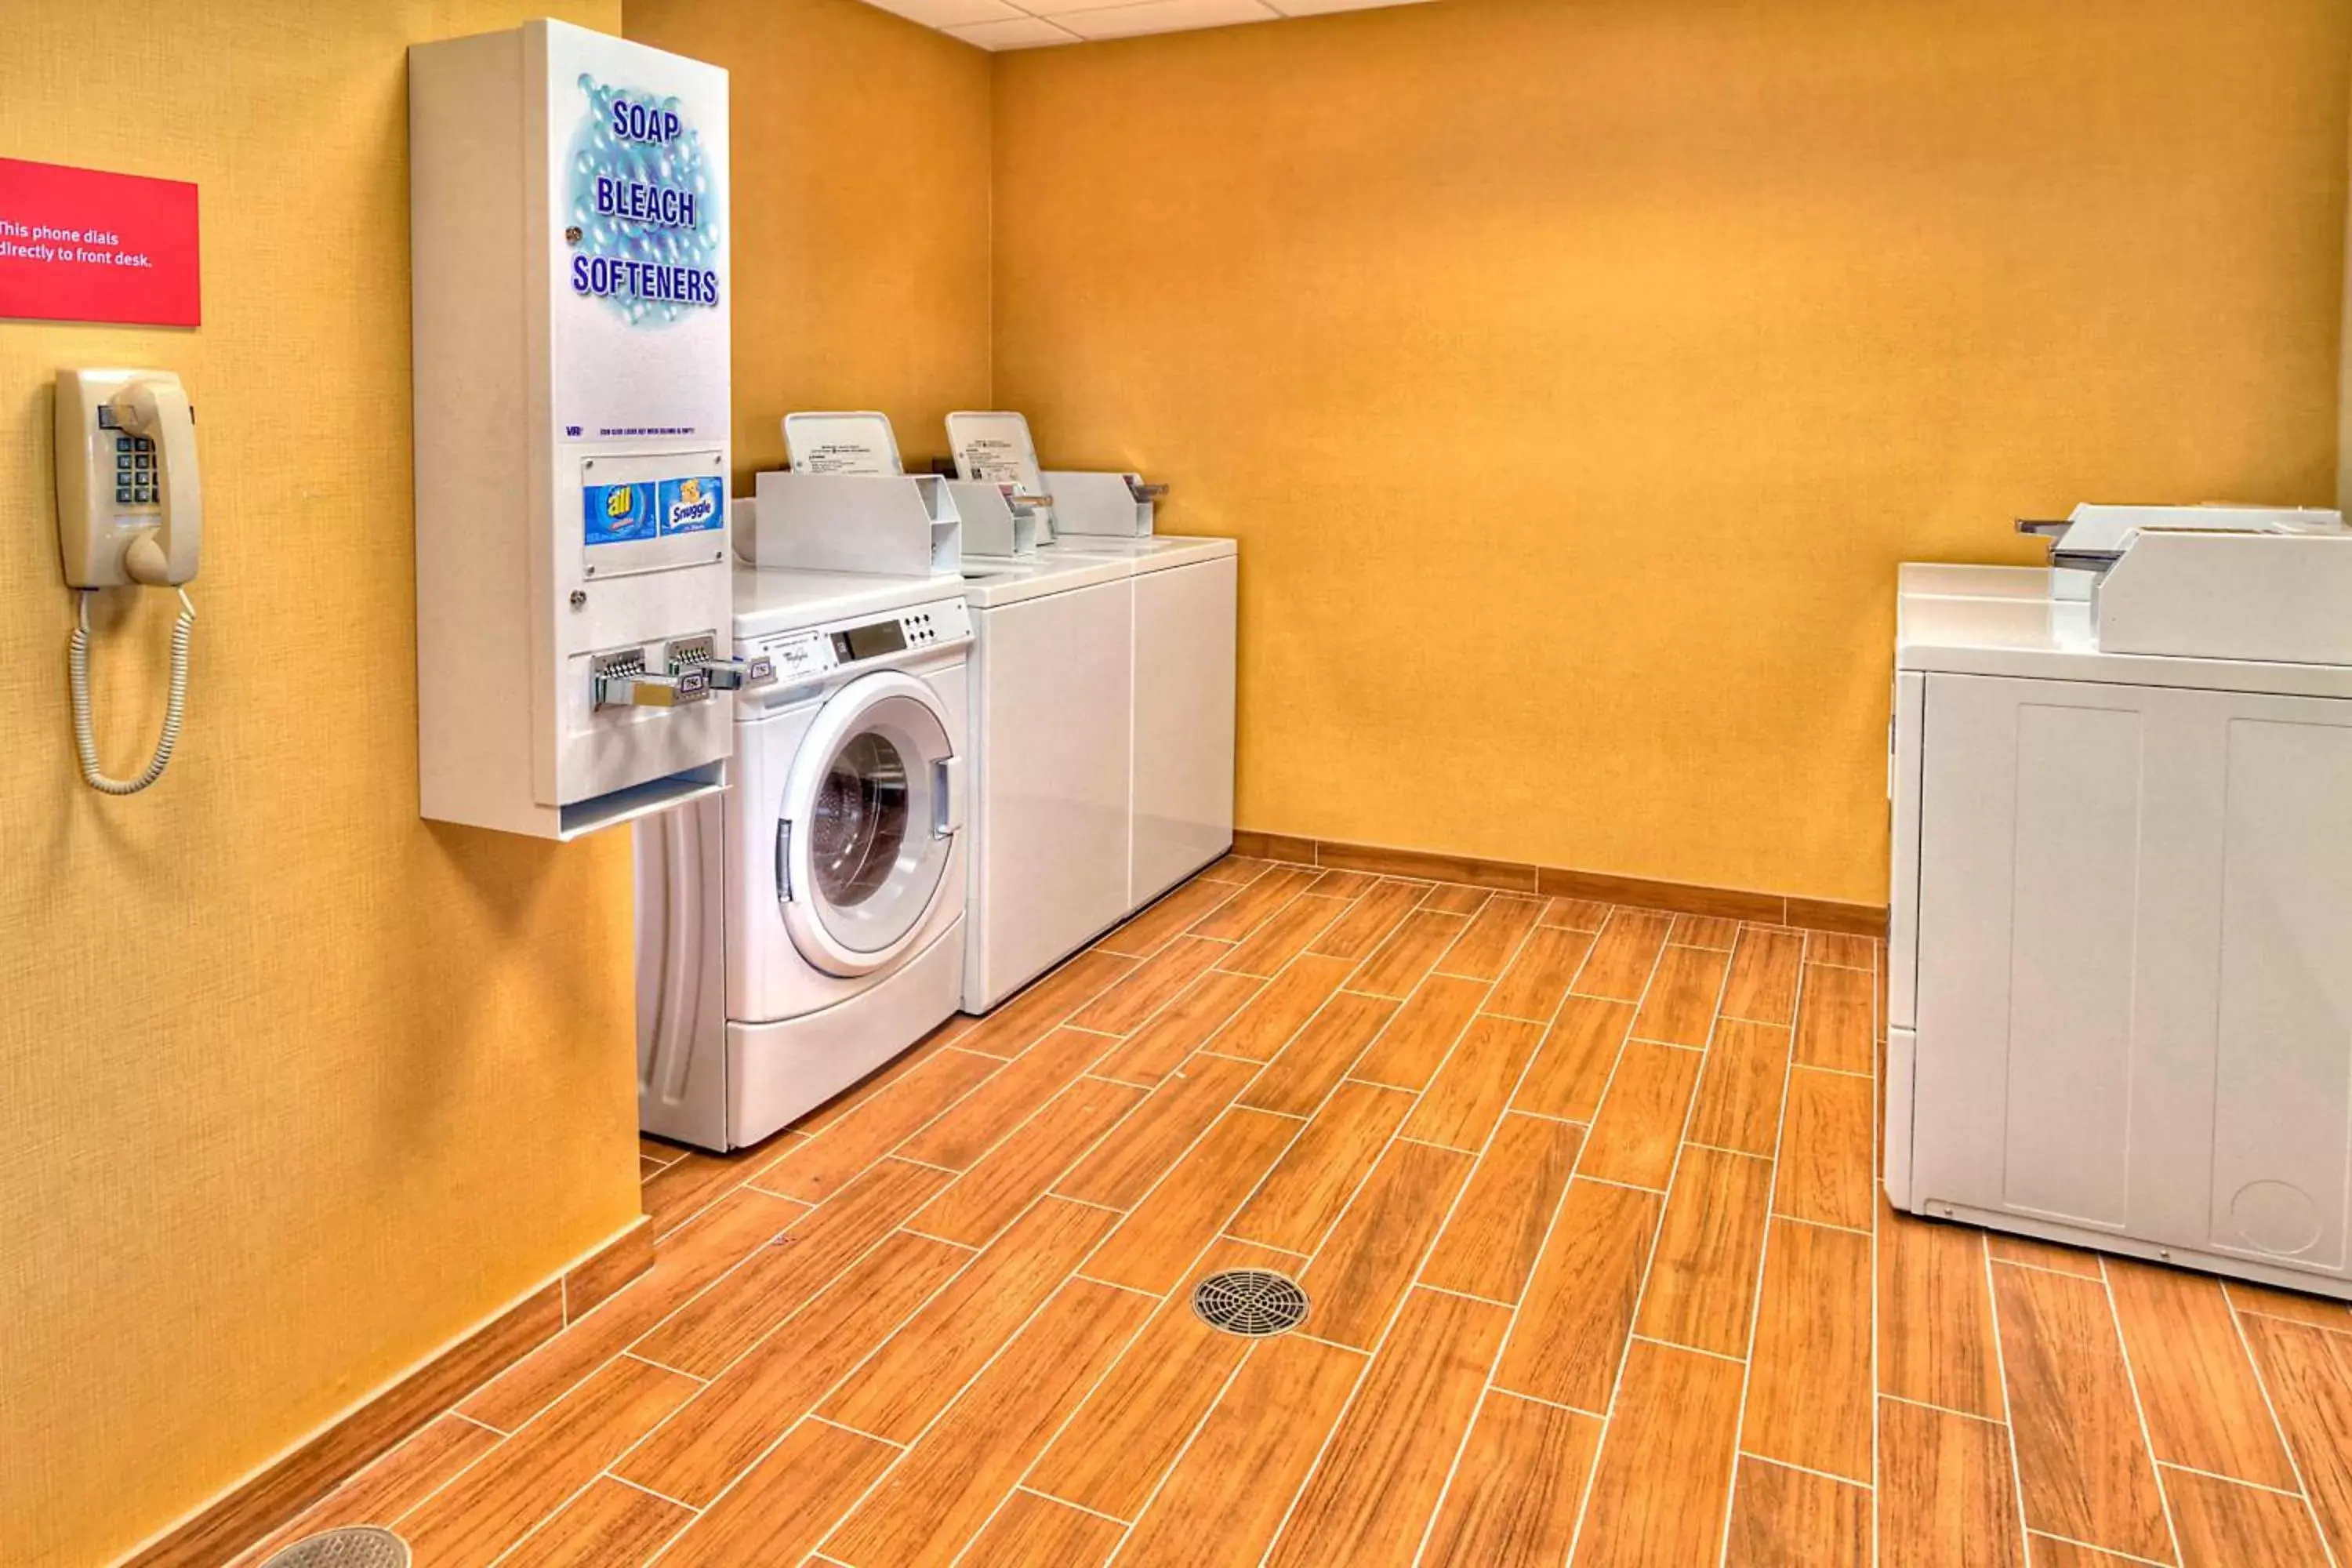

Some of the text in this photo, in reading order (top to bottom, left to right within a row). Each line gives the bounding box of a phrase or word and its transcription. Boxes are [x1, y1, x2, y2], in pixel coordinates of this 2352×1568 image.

[613, 100, 680, 143] SOAP
[597, 176, 695, 226] BLEACH
[0, 220, 119, 245] This phone dials
[0, 240, 153, 268] directly to front desk.
[573, 255, 717, 304] SOFTENERS
[608, 487, 630, 517] all
[673, 499, 711, 523] Snuggle
